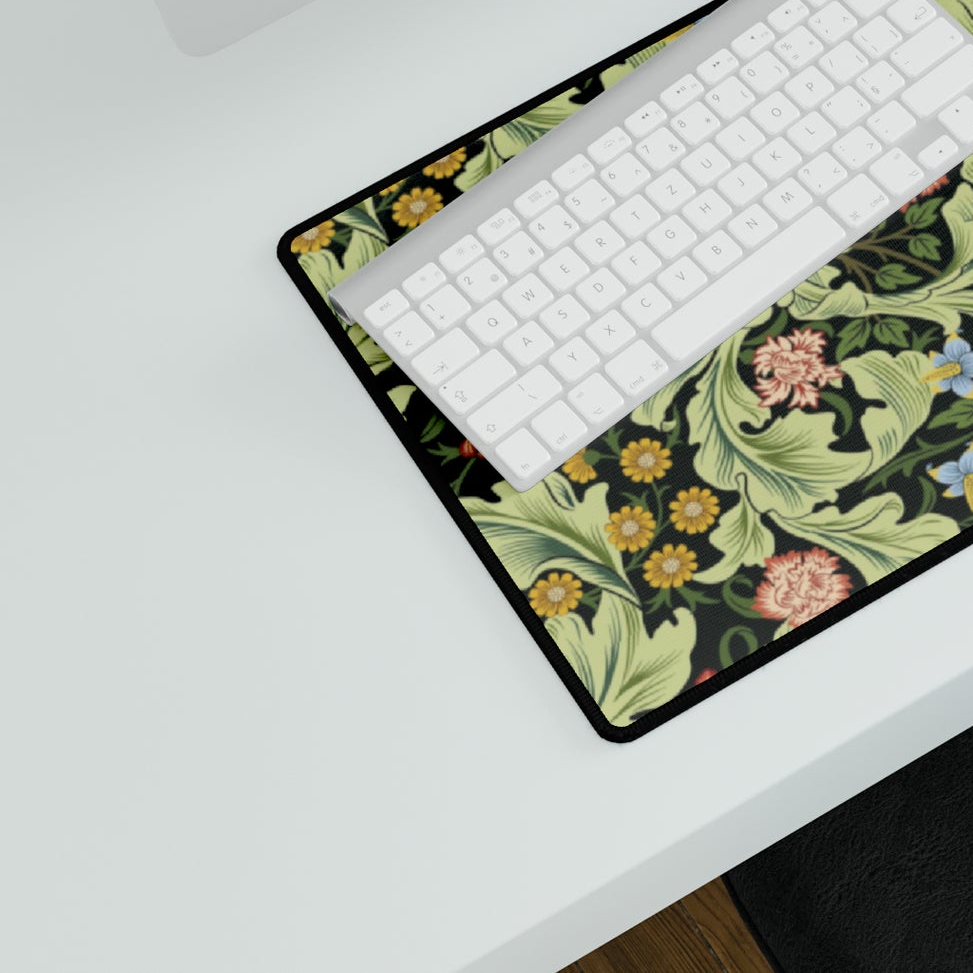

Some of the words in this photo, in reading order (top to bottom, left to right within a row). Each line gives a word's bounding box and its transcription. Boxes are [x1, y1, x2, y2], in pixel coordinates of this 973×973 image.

[463, 275, 475, 286] 2
[499, 248, 510, 259] 3
[537, 222, 546, 232] 4
[570, 195, 581, 207] 5
[607, 170, 617, 180] 6
[640, 144, 650, 155] 7
[676, 118, 687, 129] 8
[711, 93, 721, 103] 9
[486, 316, 499, 328] Q
[520, 288, 536, 302] W
[559, 263, 571, 275] E
[593, 236, 607, 248] R
[630, 209, 641, 221] T
[665, 184, 678, 196] Z
[700, 158, 713, 170] U
[770, 106, 783, 118] O
[804, 81, 816, 93] P
[521, 336, 534, 348] A
[556, 309, 568, 321] S
[592, 282, 606, 294] D
[628, 255, 639, 267] F
[664, 228, 676, 240] G
[698, 202, 712, 214] H
[736, 176, 745, 188] J
[769, 150, 783, 162] K
[804, 125, 816, 136] L
[566, 350, 578, 362] Y
[602, 324, 617, 337] X
[640, 297, 652, 308] C
[674, 270, 688, 282] V
[710, 244, 723, 256] B
[745, 217, 759, 230] N
[780, 191, 795, 204] M
